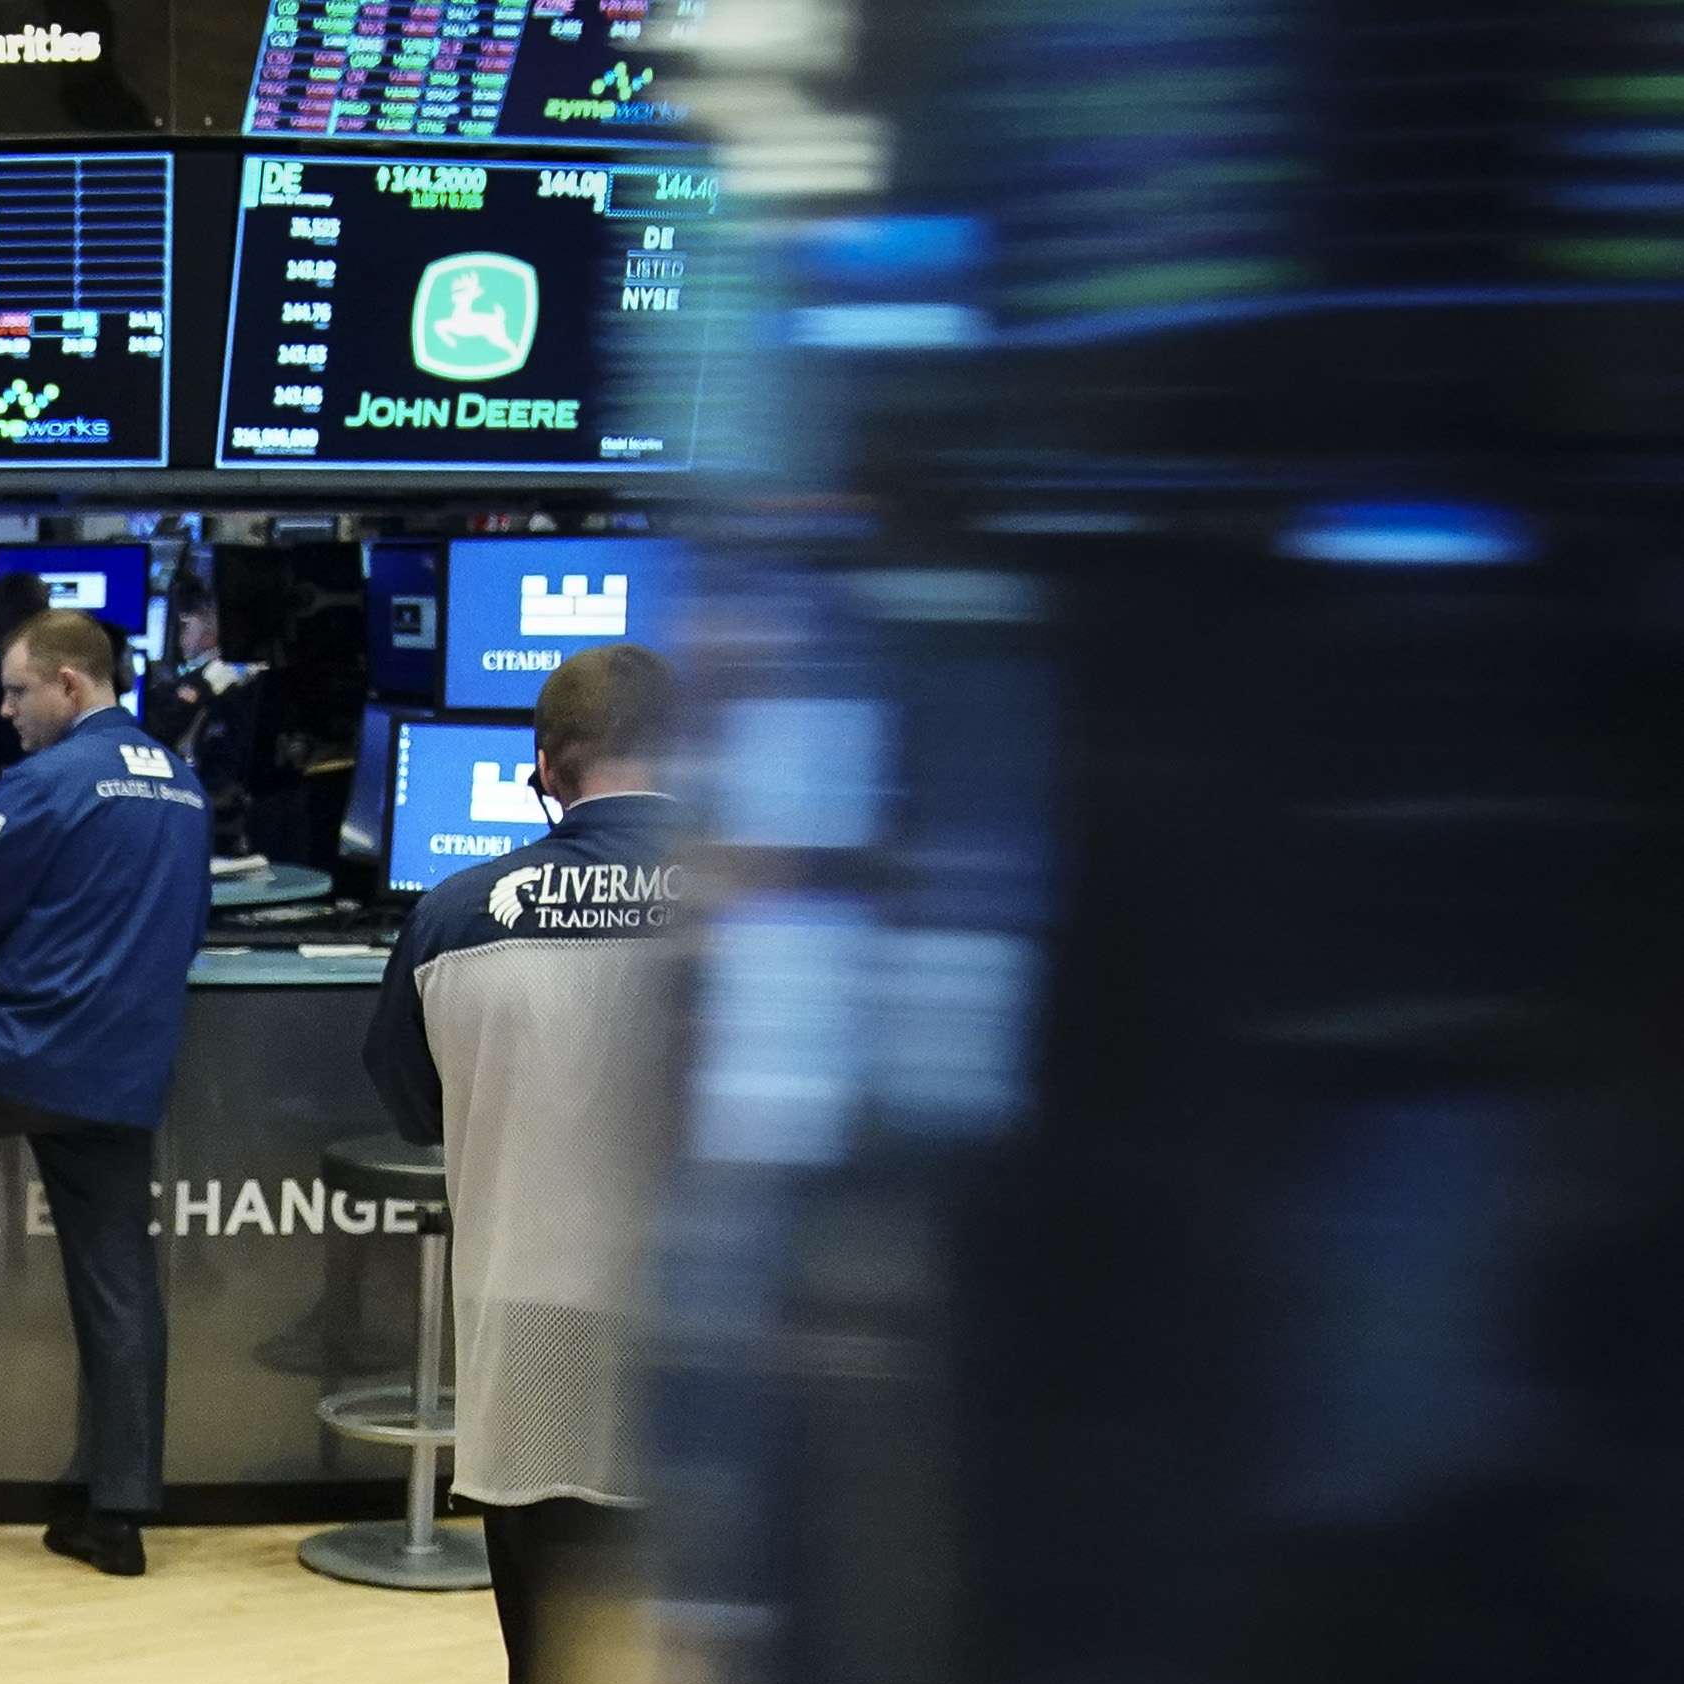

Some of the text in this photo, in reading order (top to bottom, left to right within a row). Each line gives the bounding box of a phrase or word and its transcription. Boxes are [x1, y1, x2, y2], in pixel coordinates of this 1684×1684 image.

[264, 162, 304, 194] DE
[390, 165, 487, 193] 144.2000
[644, 226, 674, 250] DE
[622, 288, 681, 311] NYSE
[344, 391, 450, 429] JOHN
[455, 392, 580, 430] DEERE
[535, 906, 640, 929] TRADING
[27, 1177, 421, 1236] EHANGE
